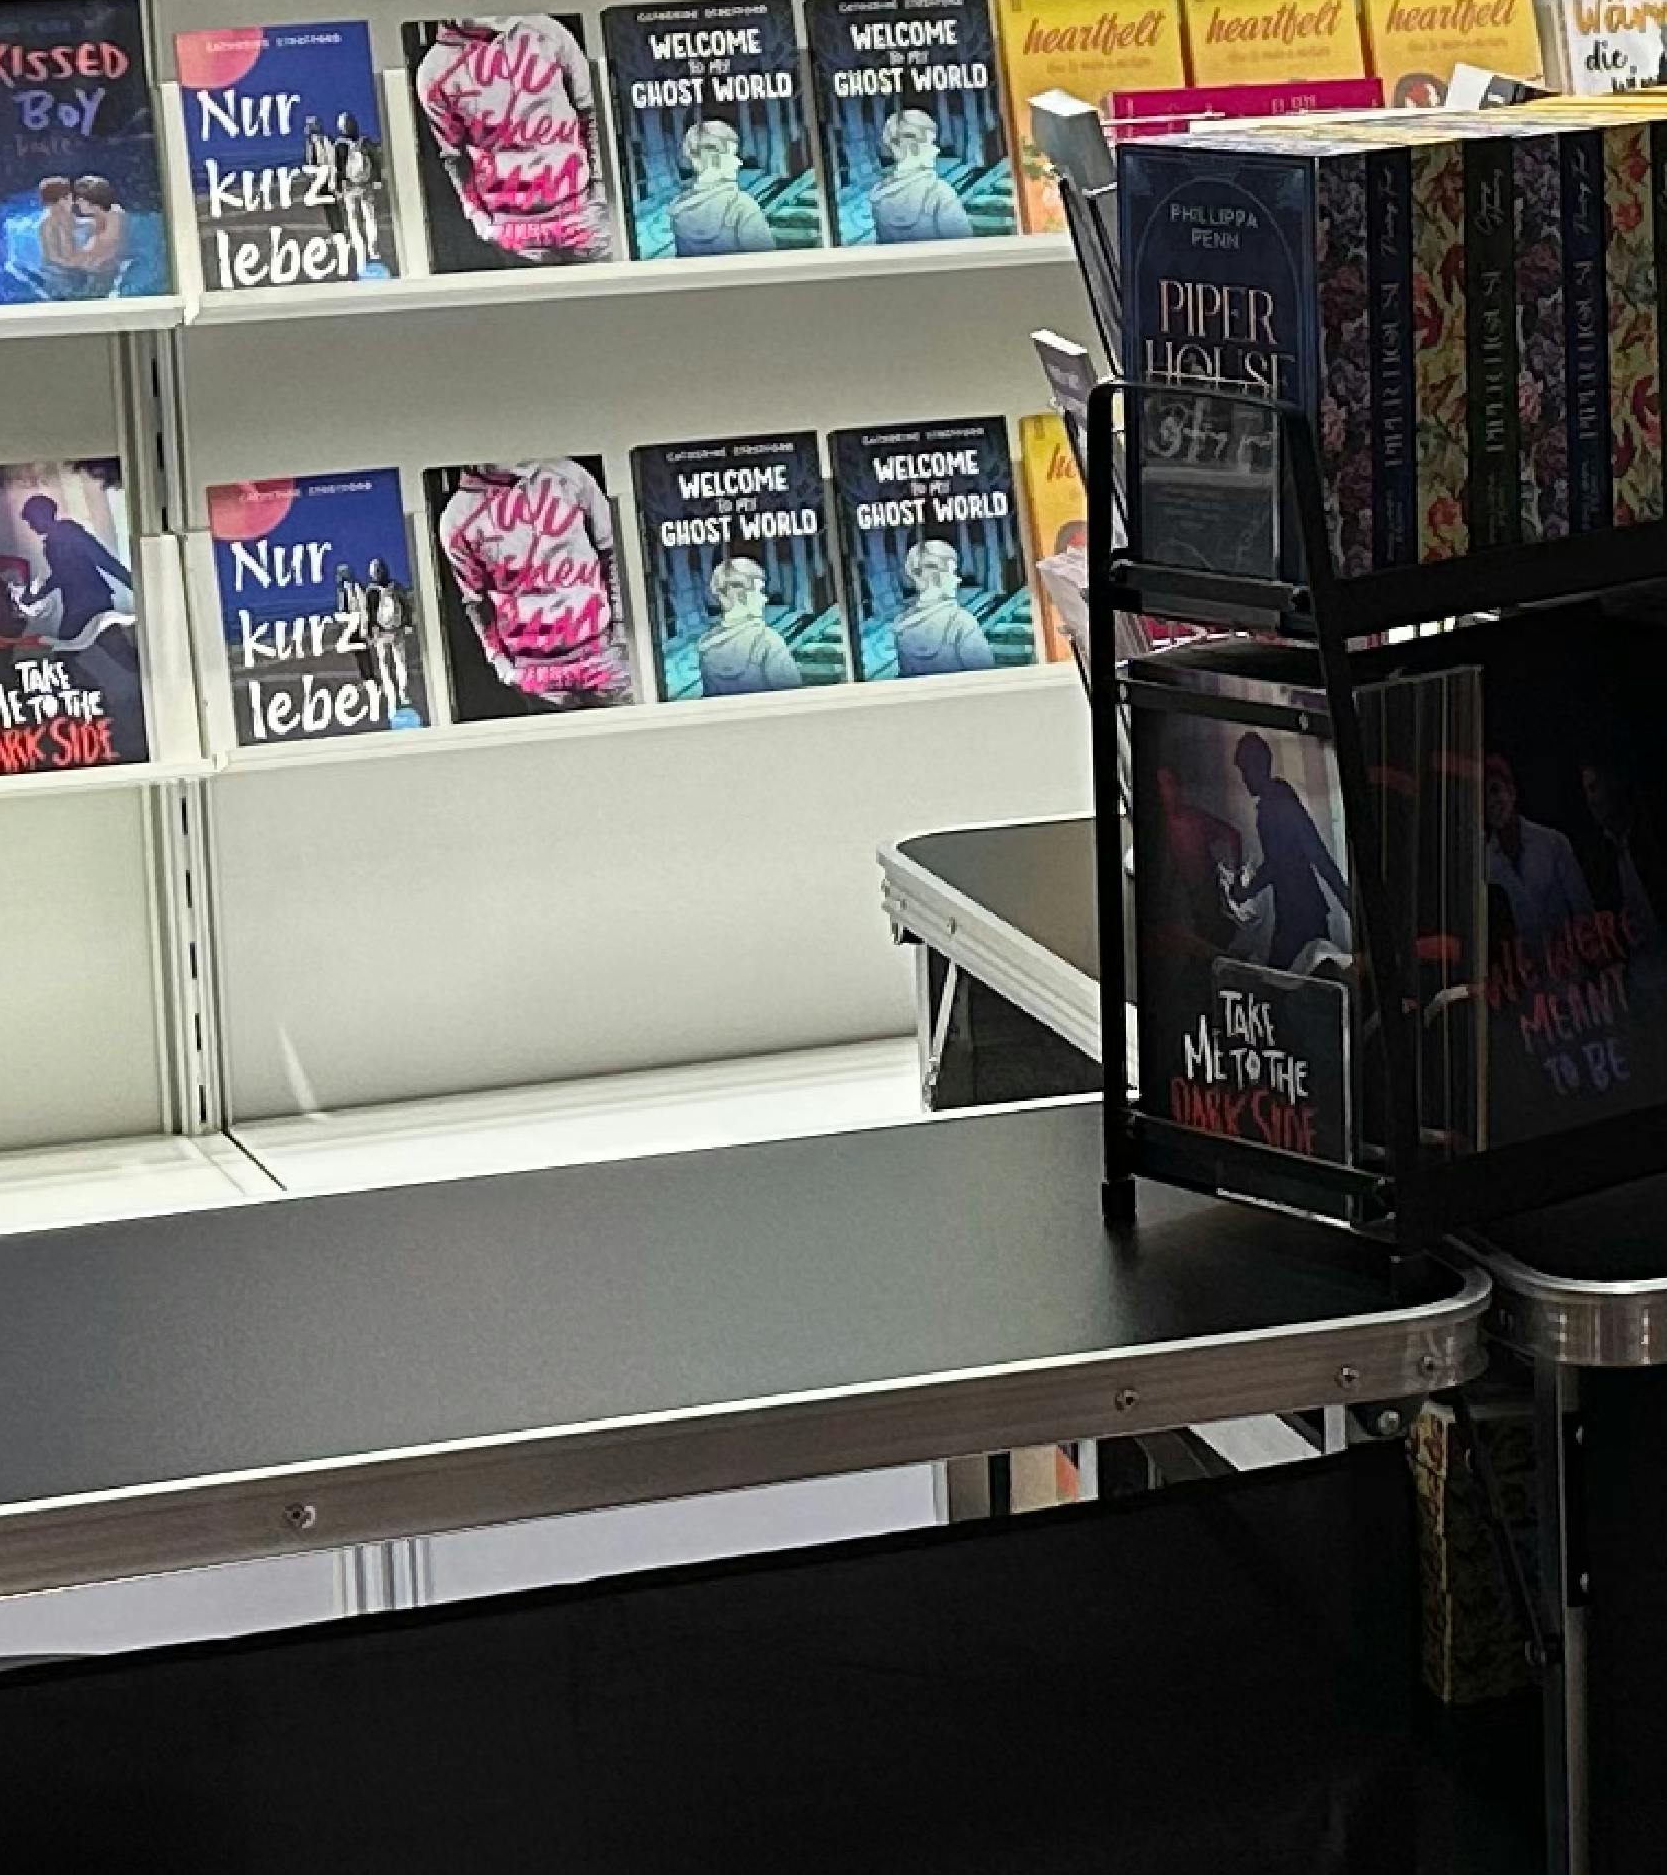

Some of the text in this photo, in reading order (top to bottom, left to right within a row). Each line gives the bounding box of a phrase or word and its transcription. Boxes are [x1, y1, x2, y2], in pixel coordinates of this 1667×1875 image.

[1191, 227, 1240, 250] PENN
[1158, 277, 1279, 346] PIPER
[677, 465, 788, 500] WELCOME
[660, 509, 819, 548] GHOST WORLD
[1218, 988, 1278, 1050] TAKE
[1517, 969, 1631, 1048] MEANT
[1183, 1023, 1311, 1096] ME TO THE
[1583, 1044, 1630, 1092] BE
[1170, 1075, 1245, 1143] DARK
